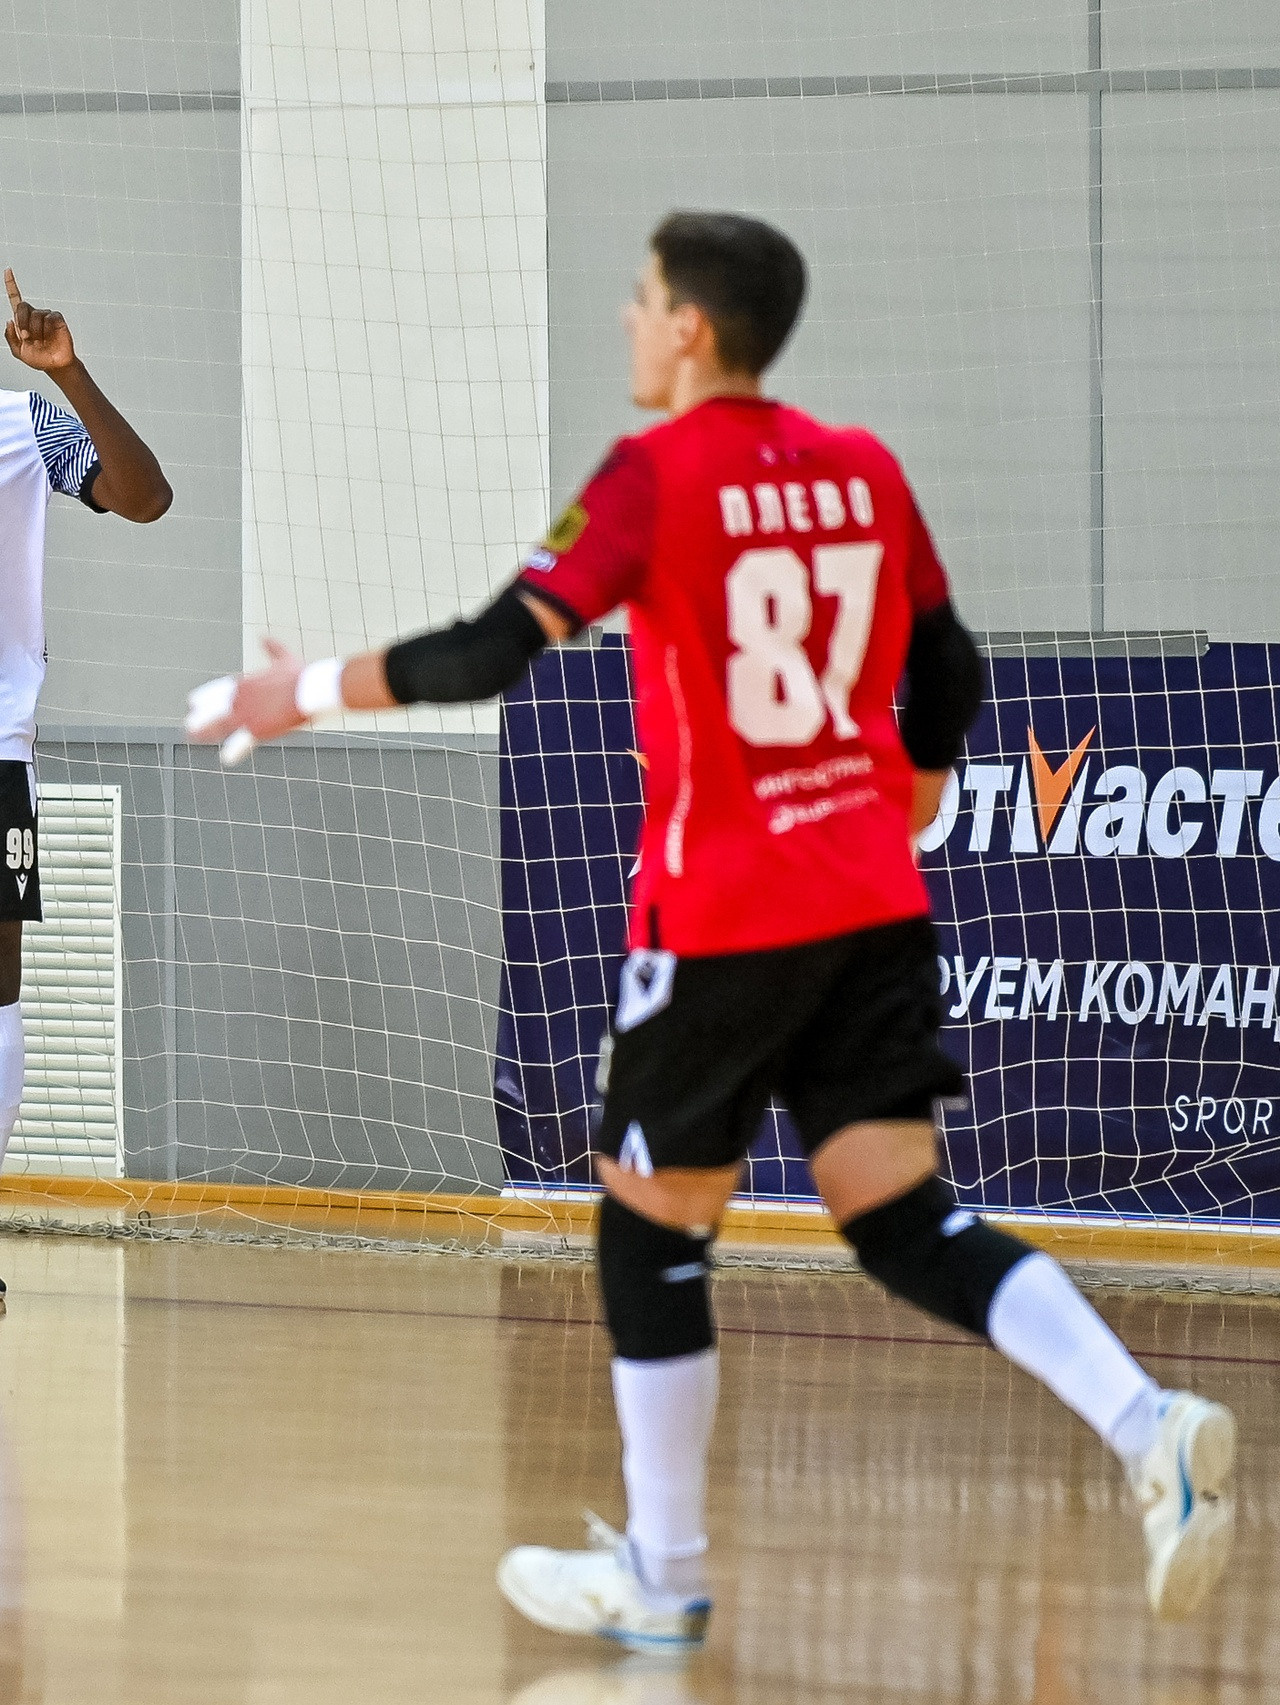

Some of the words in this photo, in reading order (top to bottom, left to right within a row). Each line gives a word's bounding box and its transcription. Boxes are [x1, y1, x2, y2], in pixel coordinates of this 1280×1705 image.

[726, 540, 885, 748] 87
[6, 827, 34, 869] 99
[1078, 960, 1280, 1042] КОМАН
[1172, 1095, 1273, 1135] SPOR
